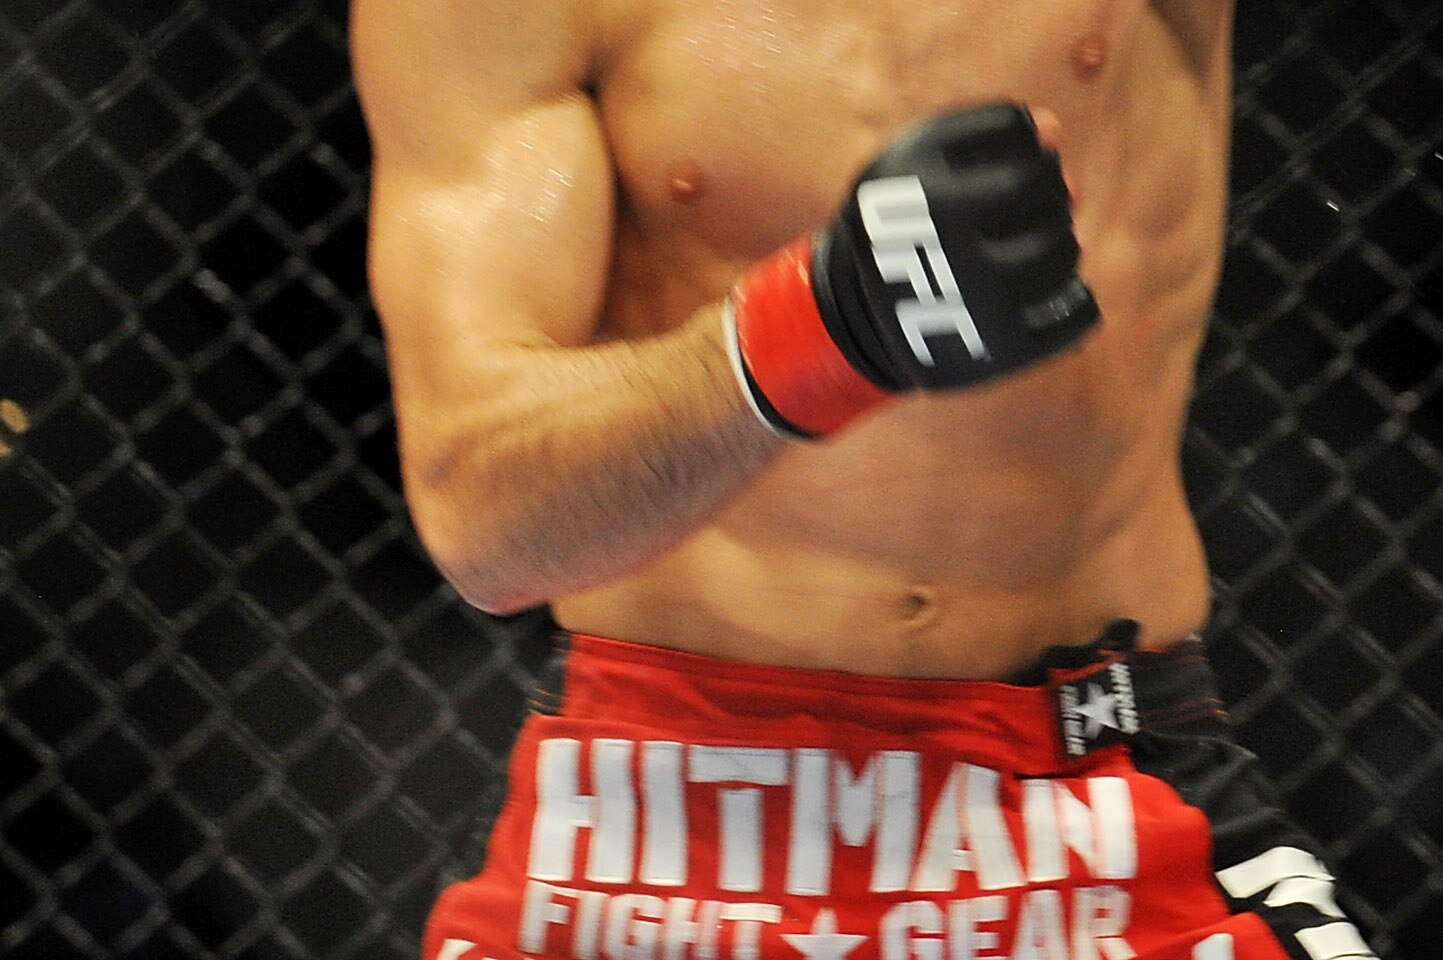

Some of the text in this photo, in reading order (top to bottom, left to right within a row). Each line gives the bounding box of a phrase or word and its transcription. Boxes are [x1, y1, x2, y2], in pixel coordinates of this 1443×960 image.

[857, 174, 990, 368] UFC
[526, 738, 1138, 897] HITMAN
[518, 880, 783, 960] FIGHT
[878, 885, 1138, 960] GEAR
